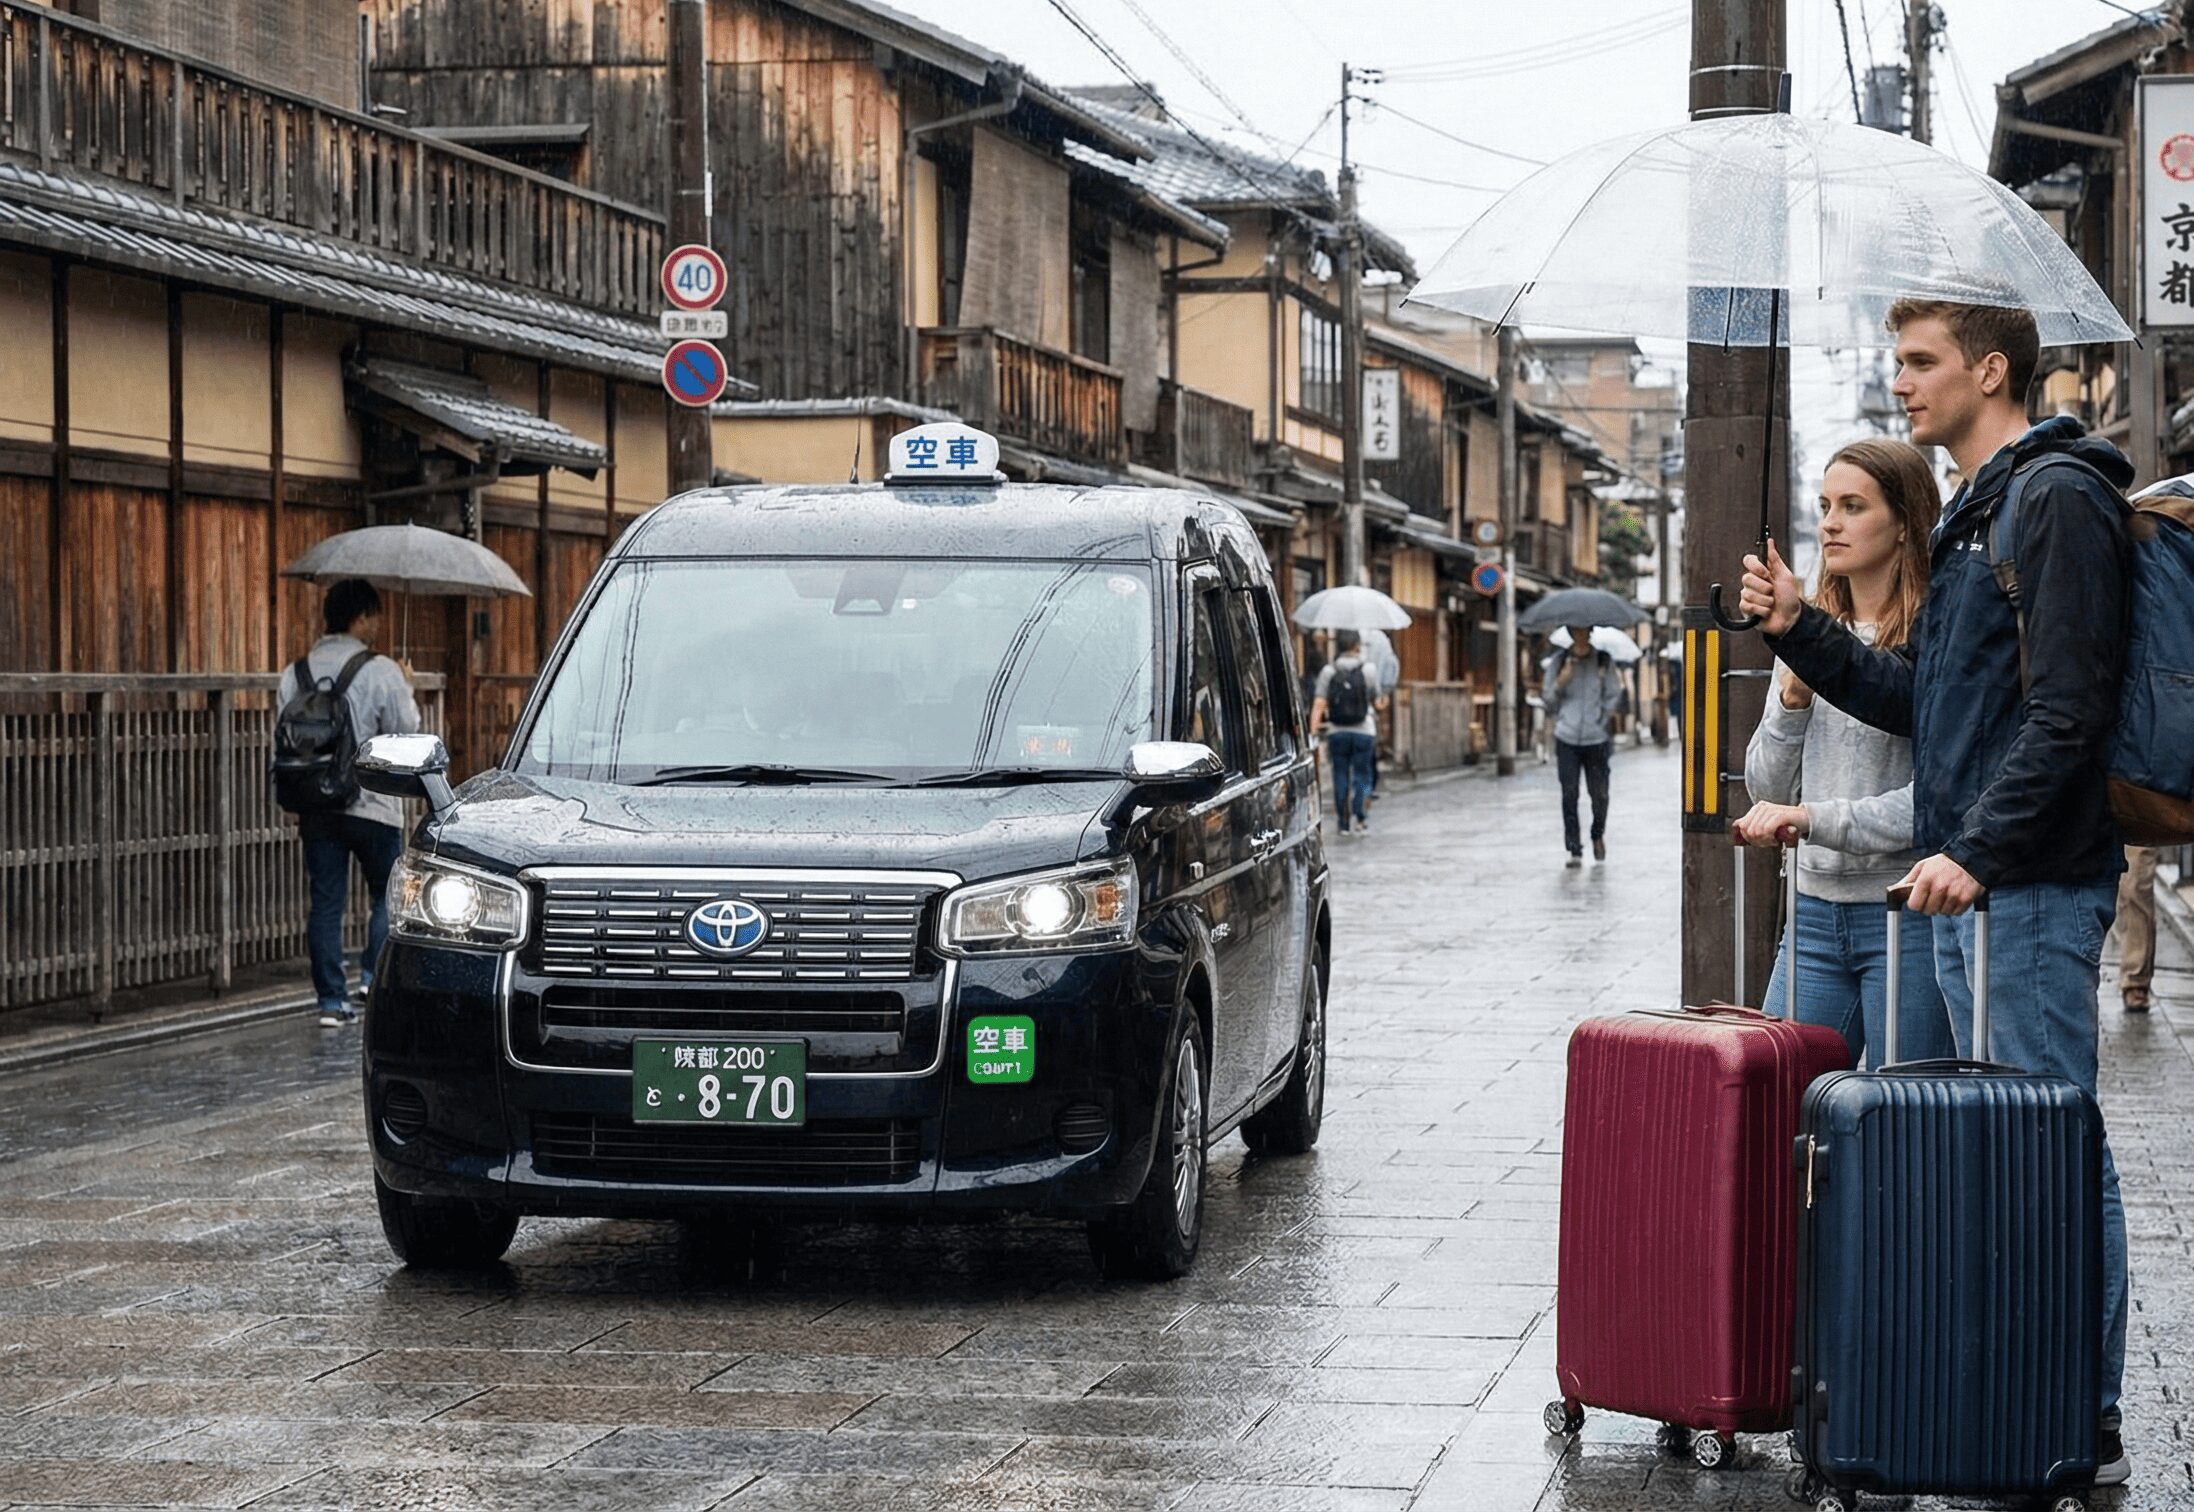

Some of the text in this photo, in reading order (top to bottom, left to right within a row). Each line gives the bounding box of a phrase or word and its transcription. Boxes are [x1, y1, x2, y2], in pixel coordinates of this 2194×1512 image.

[677, 263, 712, 292] 40
[905, 435, 978, 470] 空車
[973, 1026, 1029, 1054] 空車
[722, 1047, 765, 1069] 200
[646, 1086, 662, 1107] と
